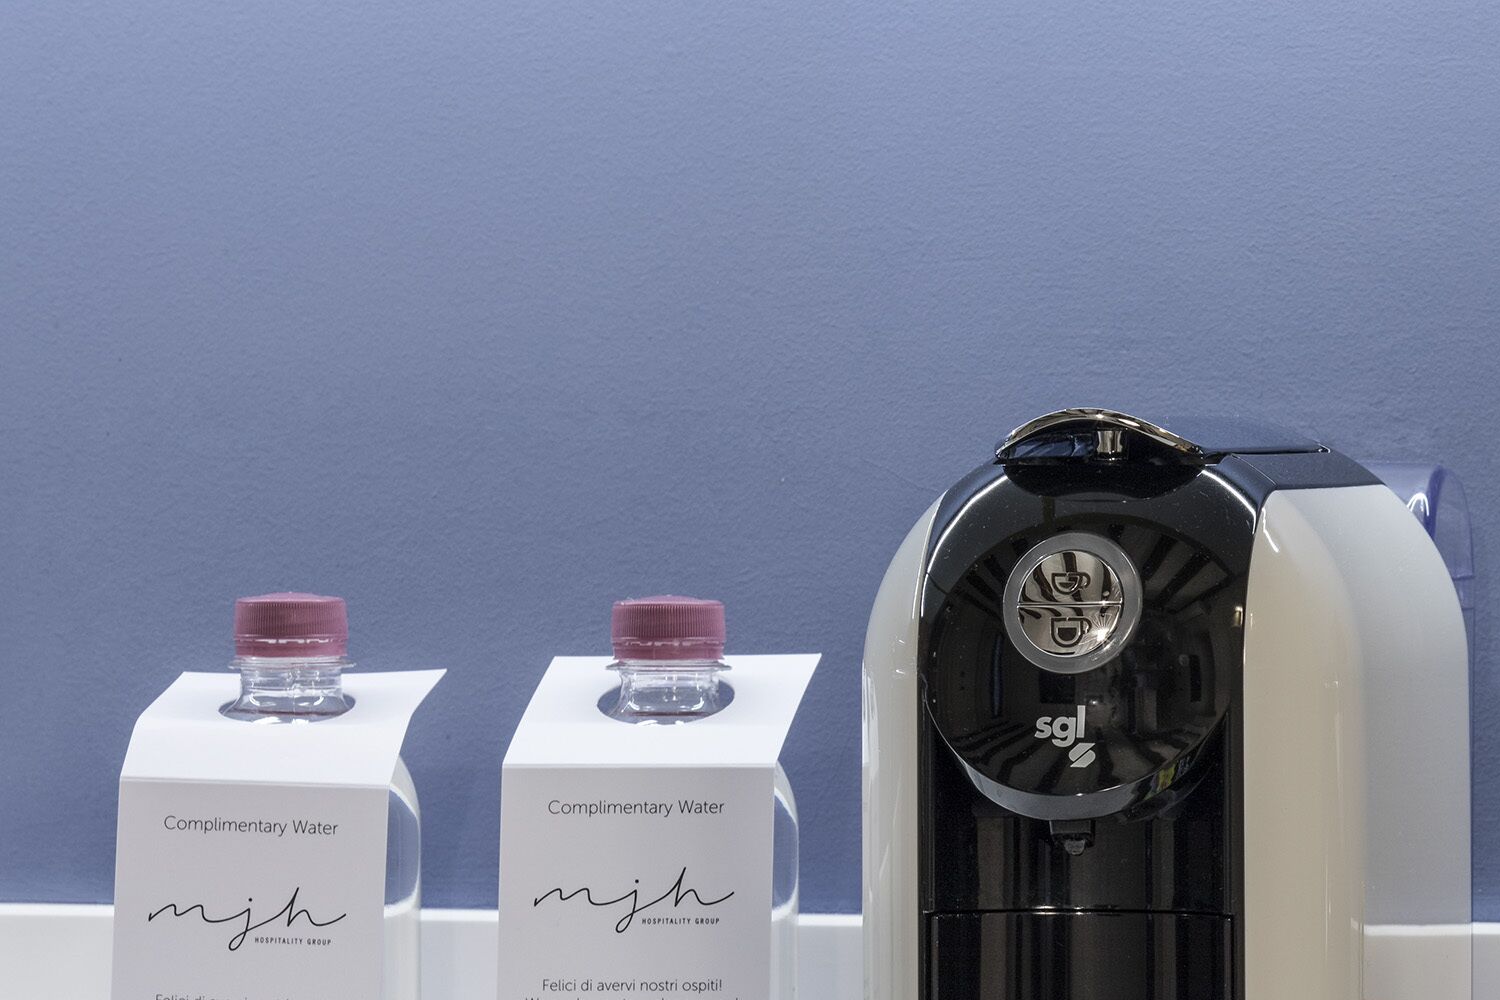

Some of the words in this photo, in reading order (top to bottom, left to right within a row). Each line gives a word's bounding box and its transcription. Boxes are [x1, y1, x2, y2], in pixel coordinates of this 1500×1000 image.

[1034, 704, 1086, 747] sgl
[548, 799, 672, 817] Complimentary
[677, 800, 725, 815] Water
[163, 815, 288, 837] Complimentary
[292, 819, 338, 836] Water
[534, 867, 735, 933] mjh
[148, 887, 347, 951] mjh
[641, 917, 692, 925] HOSPITALITY
[694, 917, 720, 925] GROUP
[254, 936, 304, 945] HOSPITALITY
[306, 938, 332, 946] GROUP
[541, 978, 576, 993] Felici
[580, 978, 593, 993] di
[596, 979, 636, 993] avervi
[639, 978, 678, 993] nostri
[681, 978, 723, 996] ospiti!
